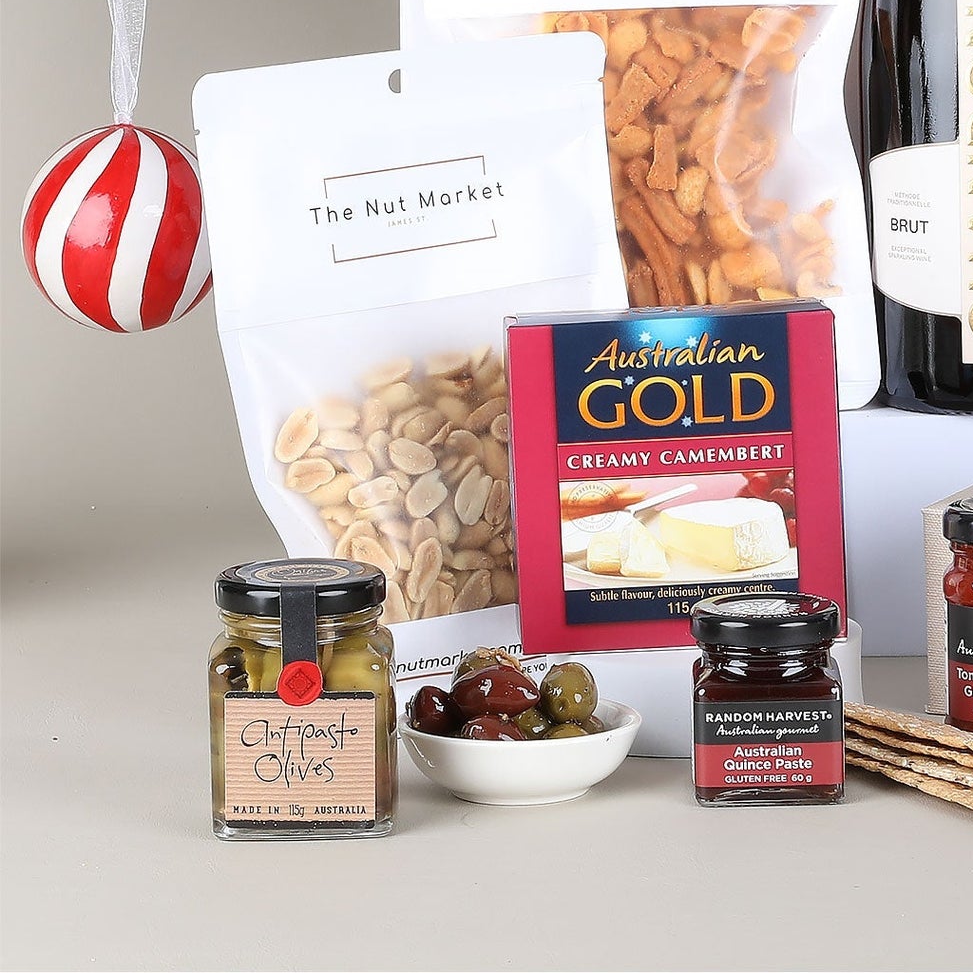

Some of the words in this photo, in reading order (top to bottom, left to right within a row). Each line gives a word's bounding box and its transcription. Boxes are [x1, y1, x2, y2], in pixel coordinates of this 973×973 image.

[309, 205, 353, 225] The
[365, 196, 407, 217] Nut
[418, 182, 505, 210] Market
[387, 217, 413, 227] JAMES
[890, 217, 929, 234] BRUT
[583, 331, 765, 373] Australian
[577, 371, 776, 430] GOLD
[566, 451, 652, 470] CREAMY
[659, 444, 785, 466] CAMEMBERT
[590, 590, 619, 602] Subtle
[621, 588, 655, 601] flavour,
[657, 585, 705, 599] deliciously
[708, 586, 742, 595] creamy
[743, 583, 776, 593] centre.
[667, 601, 690, 615] 115
[705, 711, 763, 724] RANDOM
[716, 723, 775, 737] Australian
[775, 723, 820, 740] gourmet
[734, 745, 802, 758] Australian
[254, 749, 335, 789] Olives
[723, 758, 772, 771] Quince
[775, 758, 813, 770] Paste
[724, 774, 762, 784] GLUTEN
[763, 774, 788, 783] FREE
[233, 804, 262, 815] MADE
[268, 804, 280, 815] IN
[288, 804, 305, 817] 115g
[314, 804, 367, 815] AUSTRALIA
